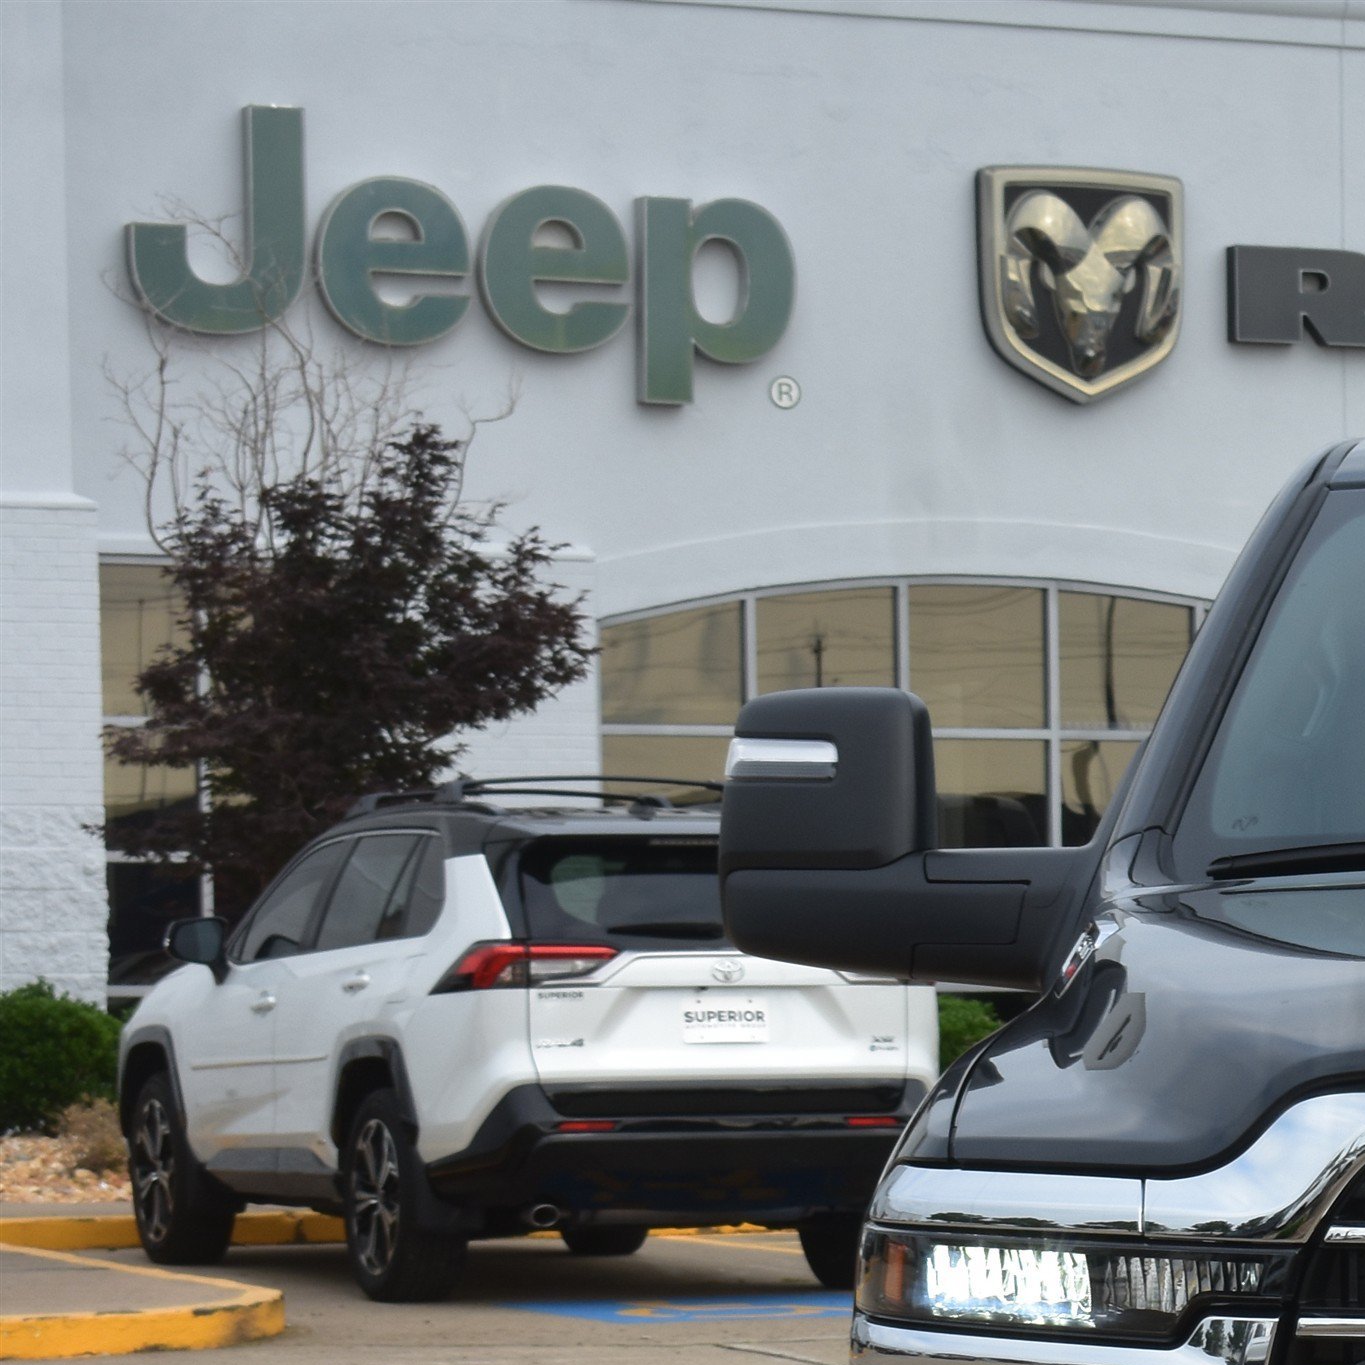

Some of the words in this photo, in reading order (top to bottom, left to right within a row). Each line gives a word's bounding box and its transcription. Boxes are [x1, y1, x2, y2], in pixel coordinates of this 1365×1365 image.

[125, 104, 796, 406] Jeep
[537, 991, 584, 1000] SUPERIOR
[683, 1010, 766, 1023] SUPERIOR
